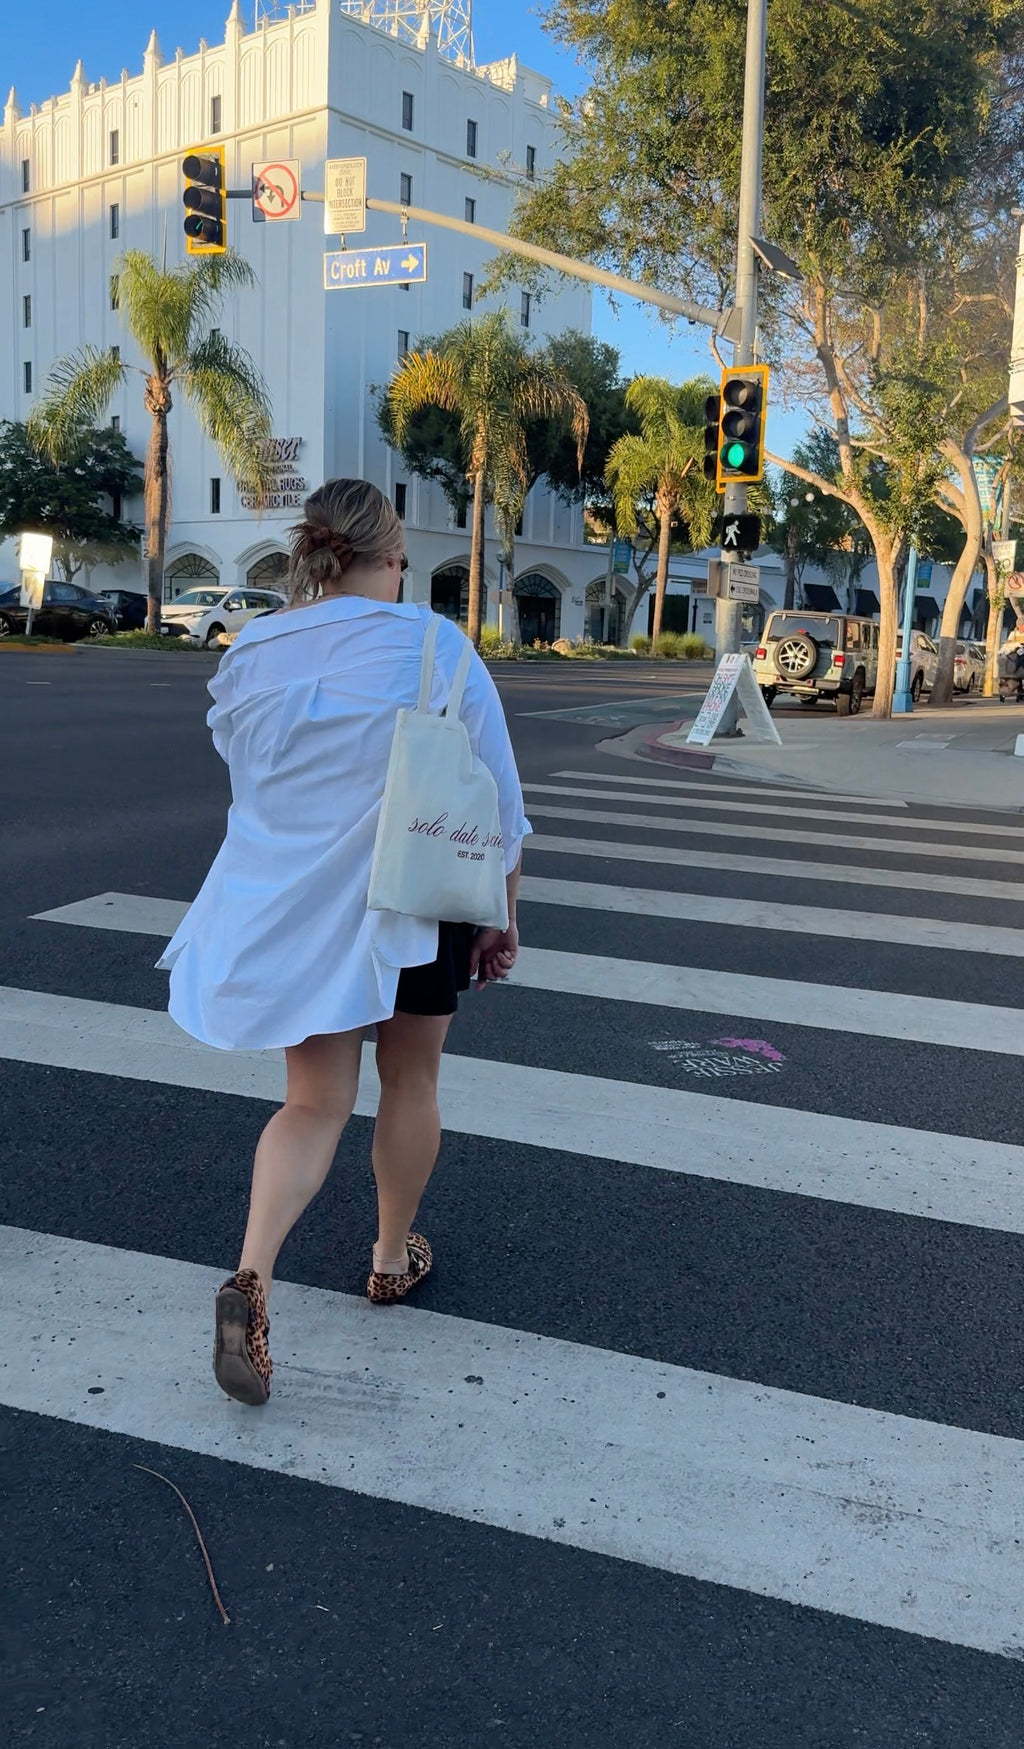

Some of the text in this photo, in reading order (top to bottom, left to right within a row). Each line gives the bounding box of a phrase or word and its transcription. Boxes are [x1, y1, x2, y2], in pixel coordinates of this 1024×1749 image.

[335, 175, 356, 188] DO NOT
[337, 187, 353, 198] BLOCK
[328, 196, 362, 209] INTERSECTION
[331, 257, 390, 280] Croft Av
[280, 476, 306, 492] RUGS
[240, 493, 302, 509] CERMIC TILE
[408, 812, 448, 837] solo
[450, 822, 478, 845] date
[457, 849, 485, 861] EST. 2020
[672, 1055, 761, 1072] WARE
[693, 1062, 783, 1078] JESSIE
